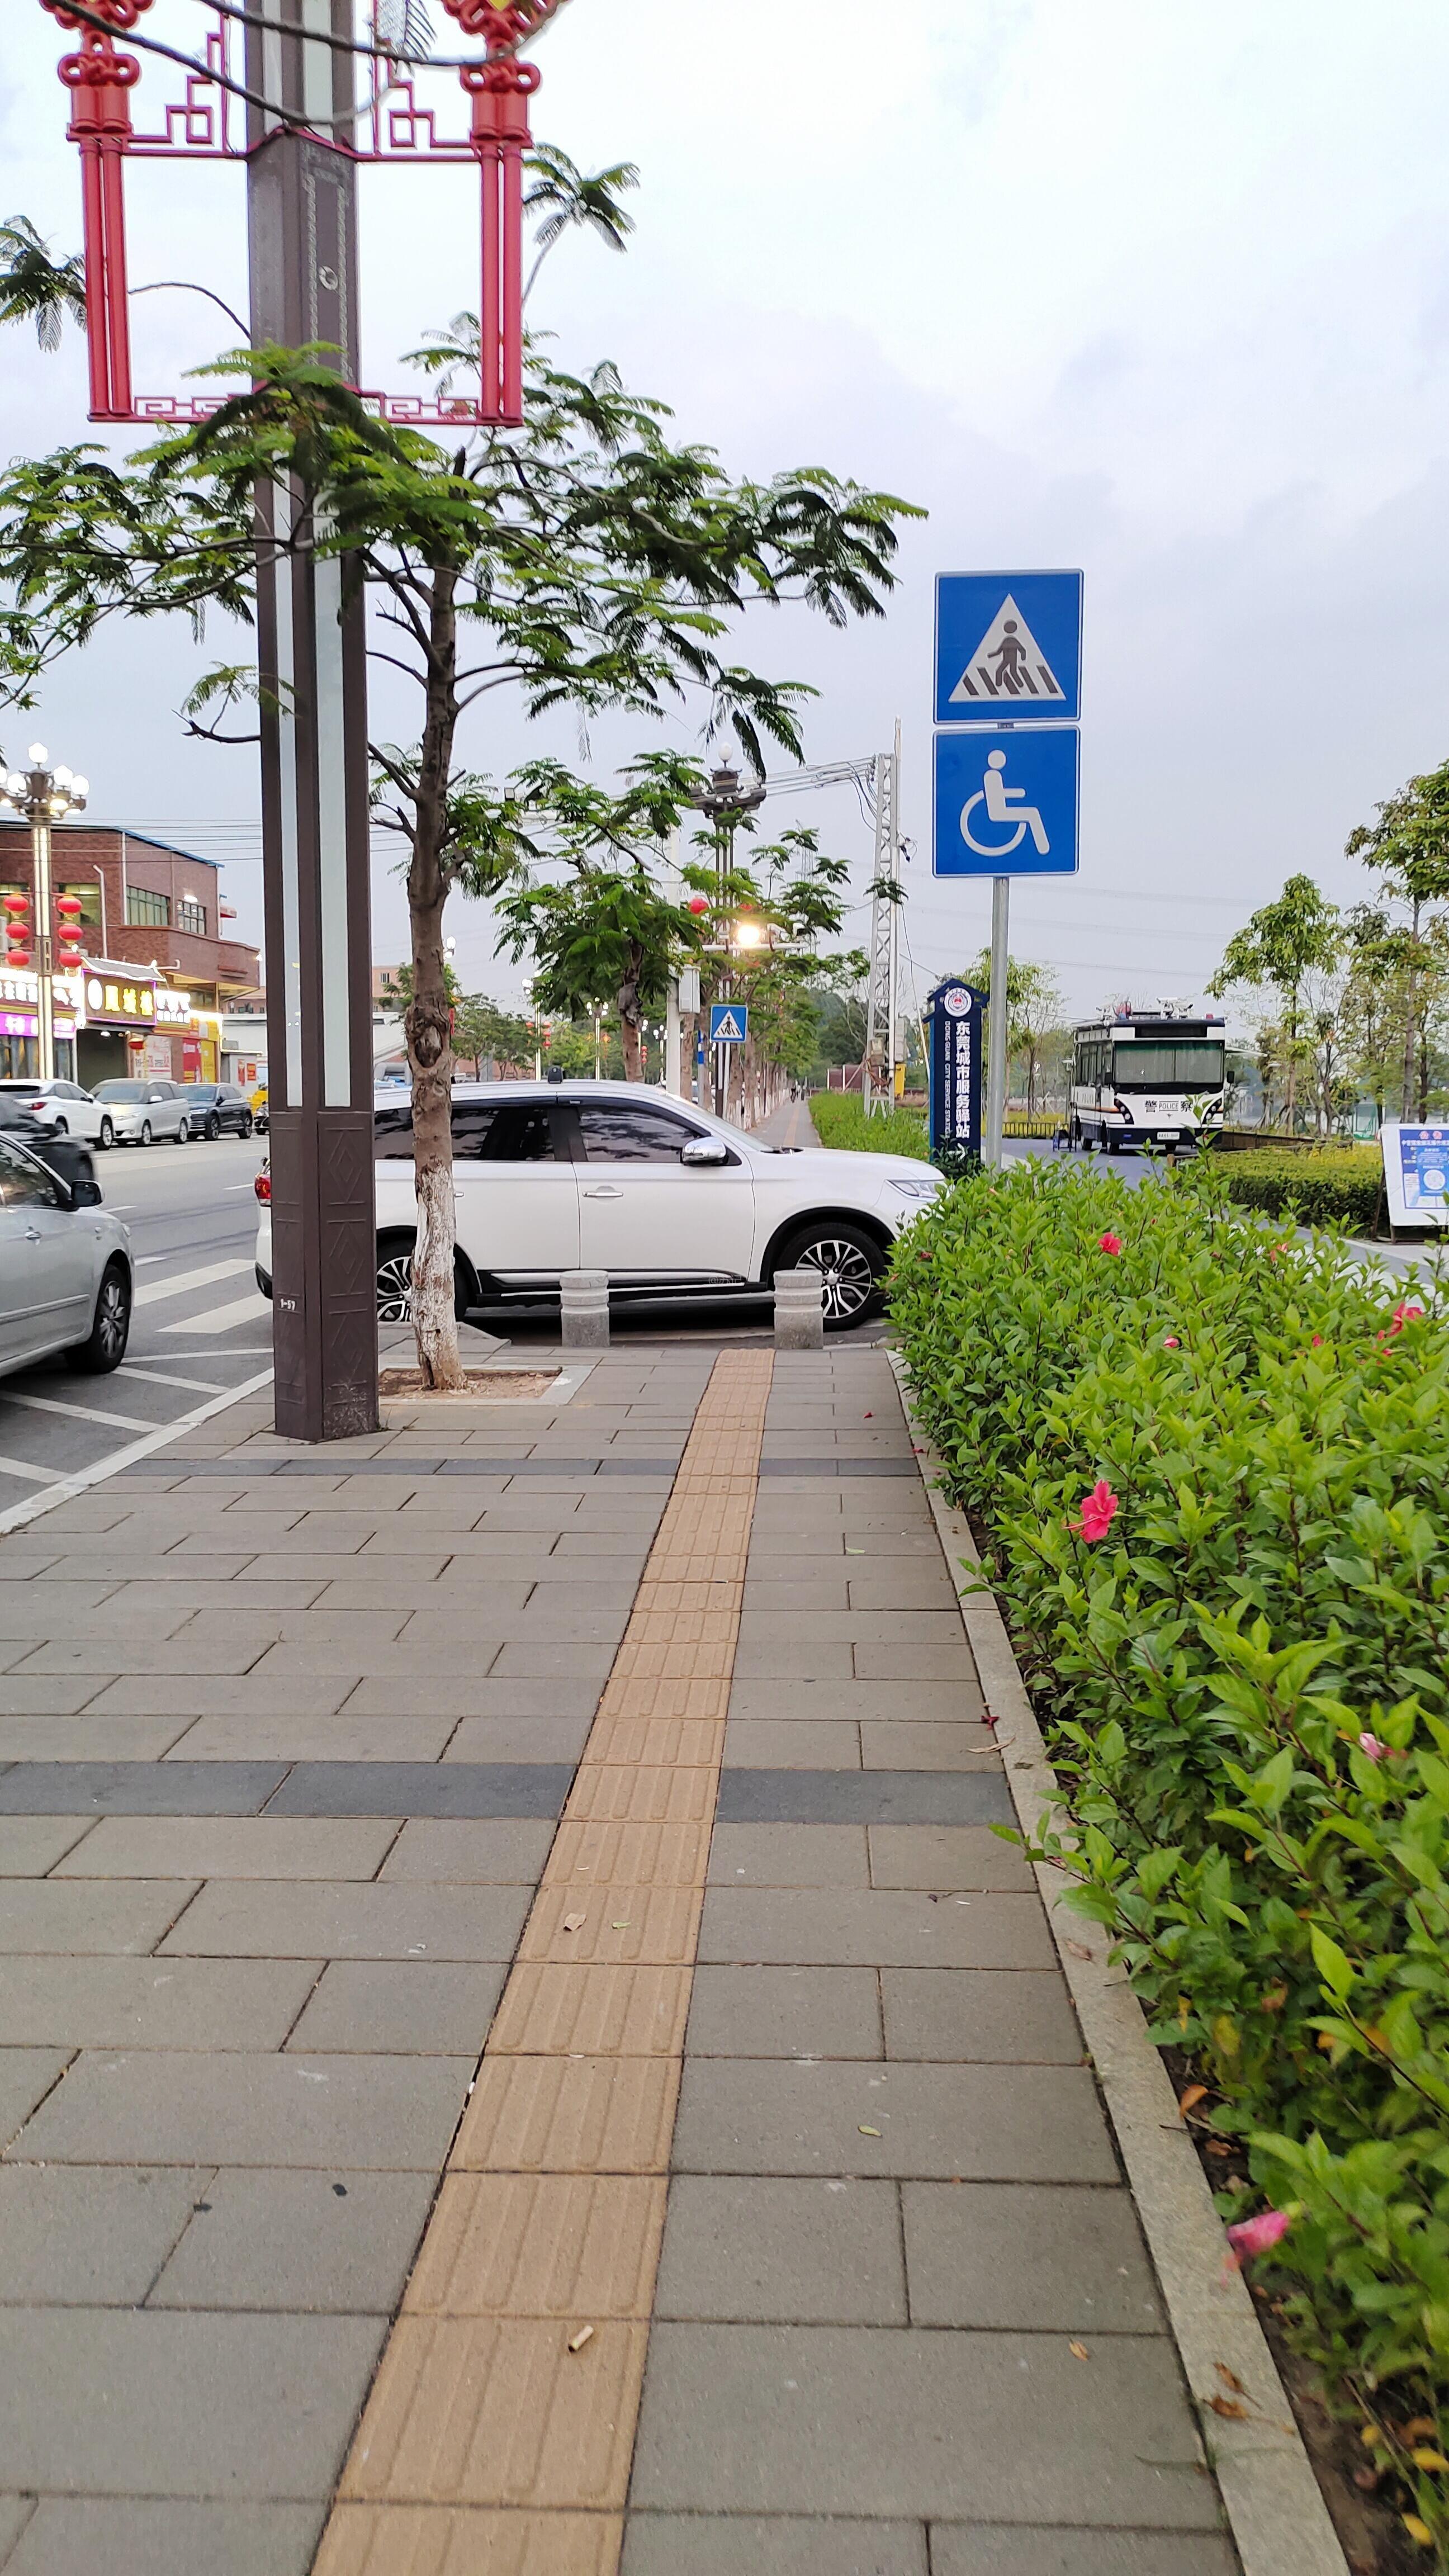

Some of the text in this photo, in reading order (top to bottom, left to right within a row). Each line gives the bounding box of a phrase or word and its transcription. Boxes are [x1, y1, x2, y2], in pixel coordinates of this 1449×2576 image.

[956, 1021, 970, 1139] 东莞城市服务驿站
